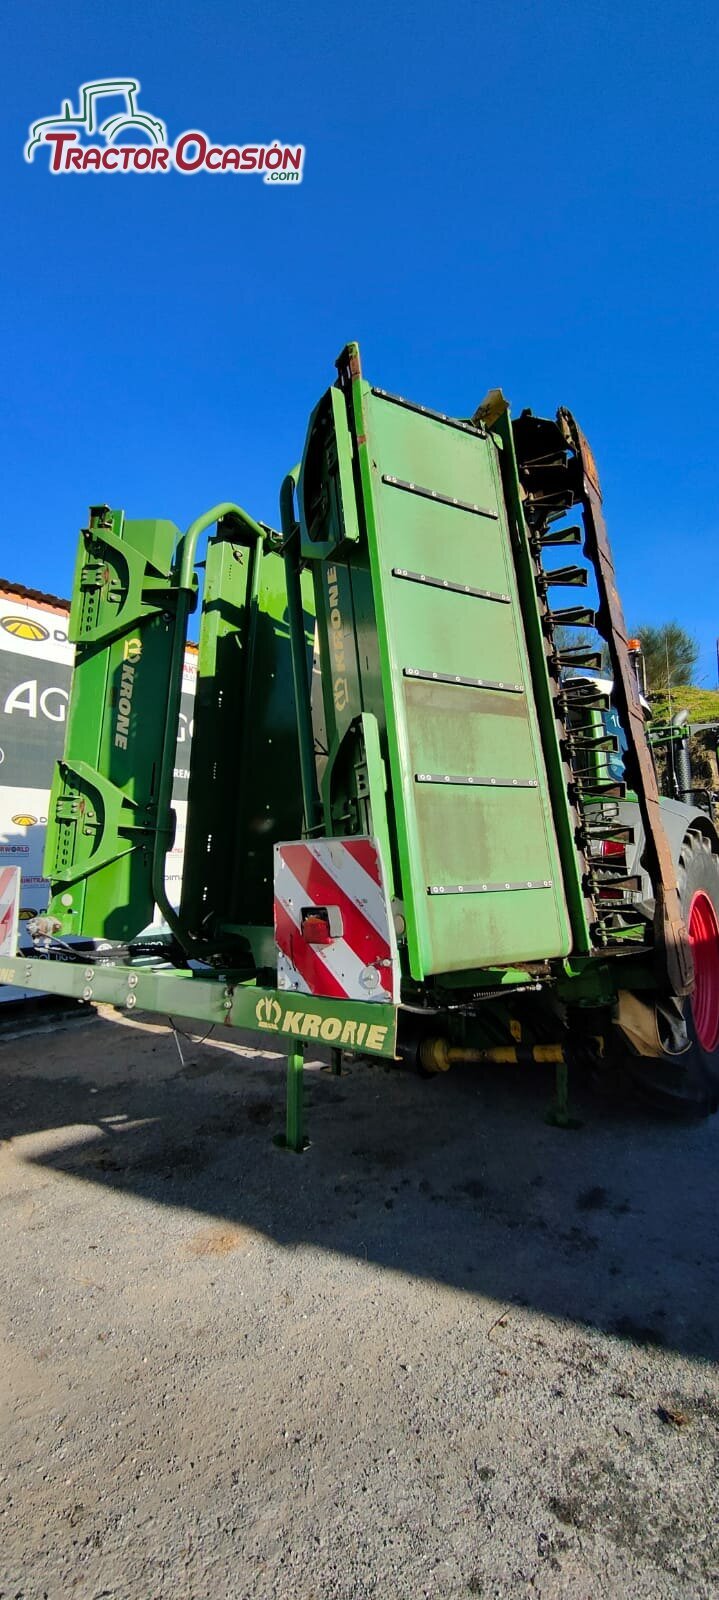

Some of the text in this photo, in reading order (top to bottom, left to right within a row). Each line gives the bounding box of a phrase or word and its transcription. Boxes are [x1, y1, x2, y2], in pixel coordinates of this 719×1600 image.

[326, 565, 346, 674] KRONE
[114, 663, 135, 751] KRONE
[281, 1010, 388, 1050] KRONE
